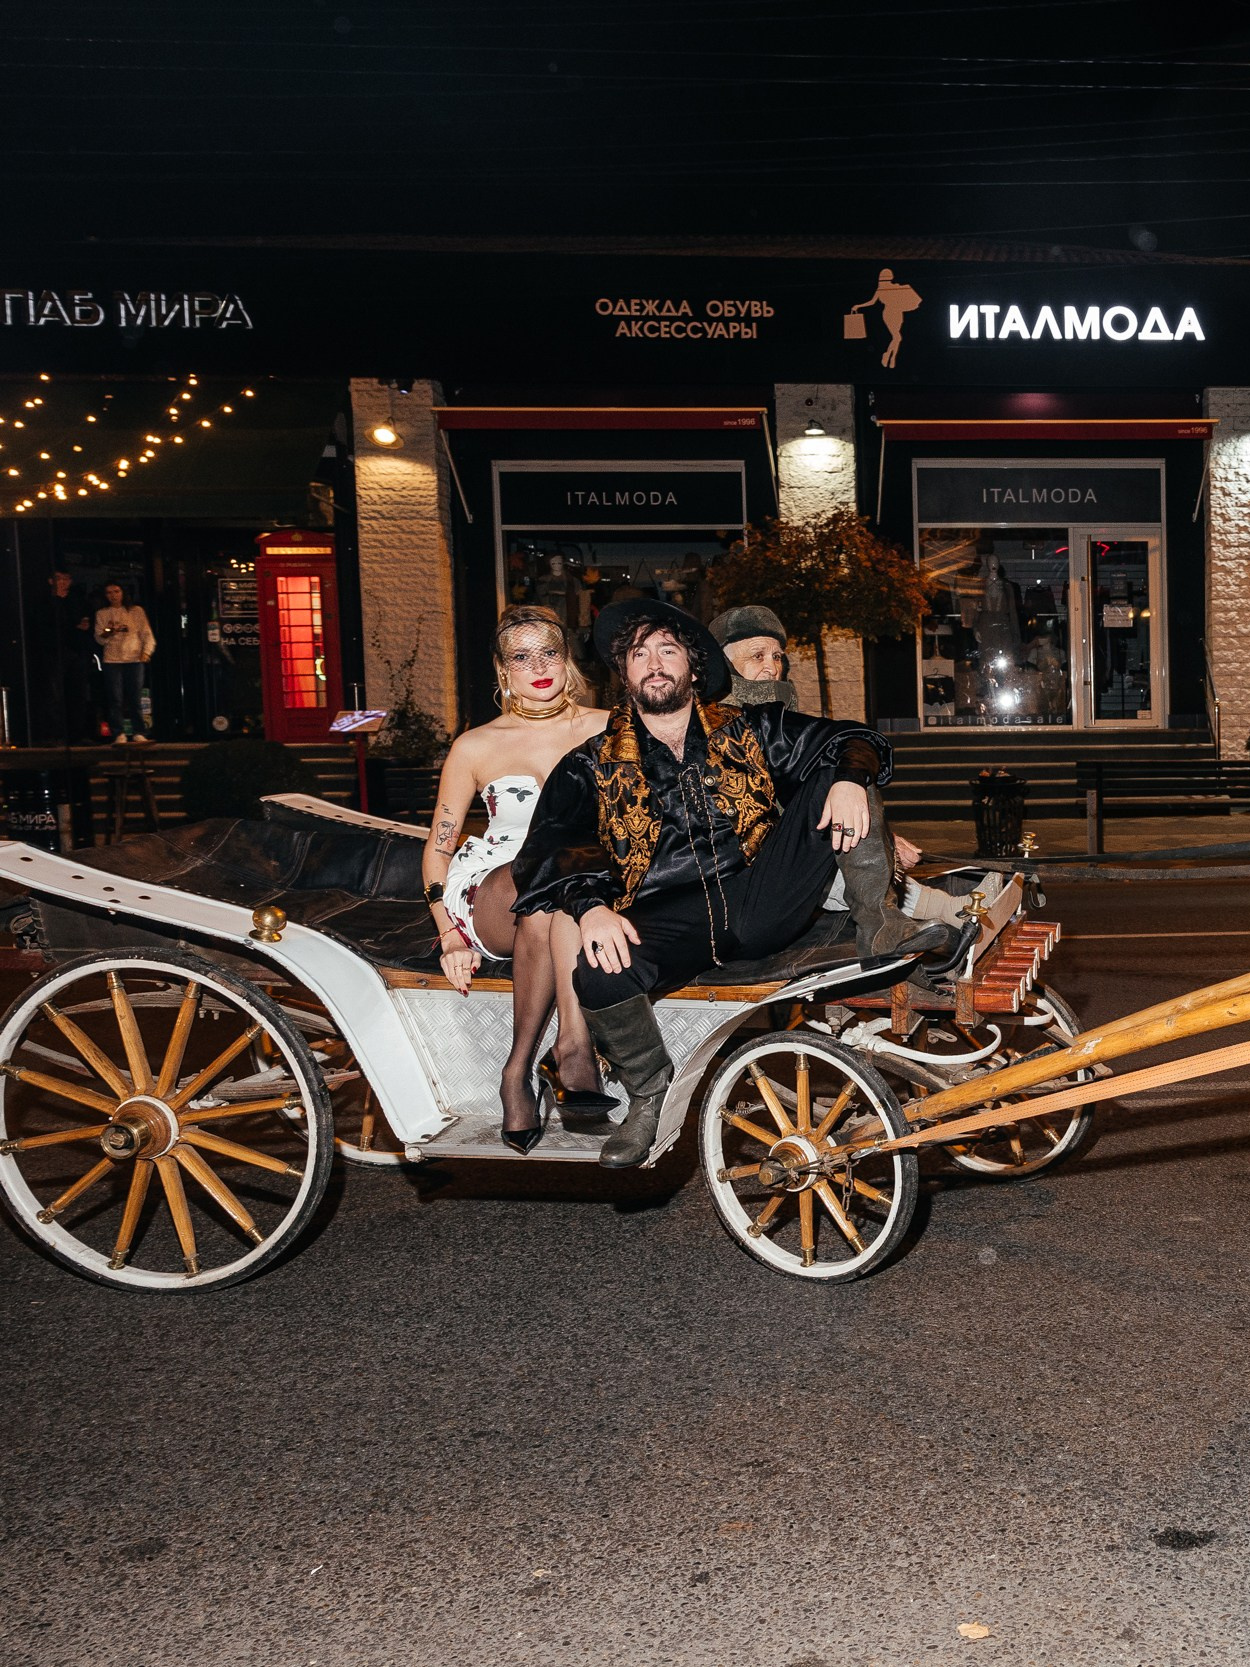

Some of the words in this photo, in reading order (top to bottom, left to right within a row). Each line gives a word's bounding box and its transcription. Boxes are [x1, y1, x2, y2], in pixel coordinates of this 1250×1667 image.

[0, 289, 105, 327] ПАБ
[113, 290, 254, 329] МИРА
[595, 298, 694, 316] ОДЕЖДА
[706, 300, 775, 317] ОБУВЬ
[615, 320, 758, 339] АКСЕССУАРЫ
[949, 304, 1206, 341] ИТАЛМОДА
[737, 418, 756, 426] 1996
[567, 491, 678, 506] ITALMODA
[982, 488, 1098, 503] ITALMODA
[221, 637, 237, 646] НА
[238, 637, 260, 646] СЕБ
